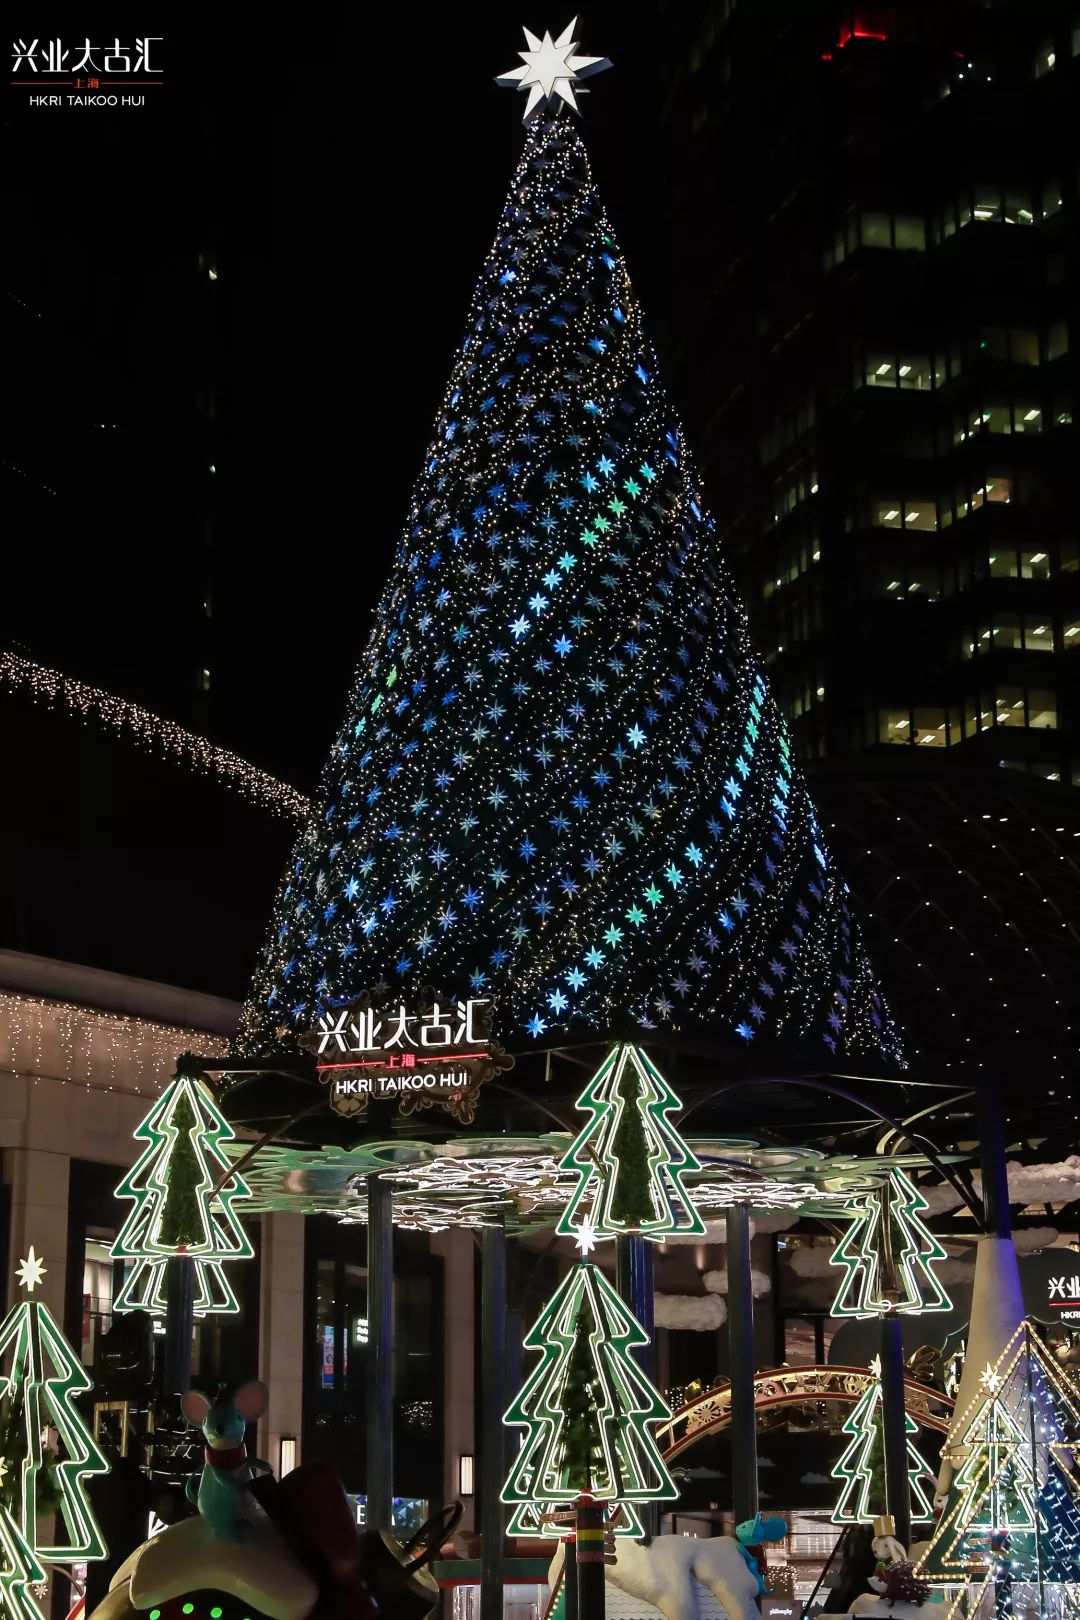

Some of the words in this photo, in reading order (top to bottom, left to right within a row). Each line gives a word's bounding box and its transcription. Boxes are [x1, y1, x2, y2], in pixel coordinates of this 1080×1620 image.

[317, 999, 490, 1054] 兴业太古汇
[386, 1053, 415, 1069] 上海
[336, 1079, 372, 1094] HKRI
[378, 1074, 436, 1091] TAIKOO
[440, 1072, 467, 1087] HUI
